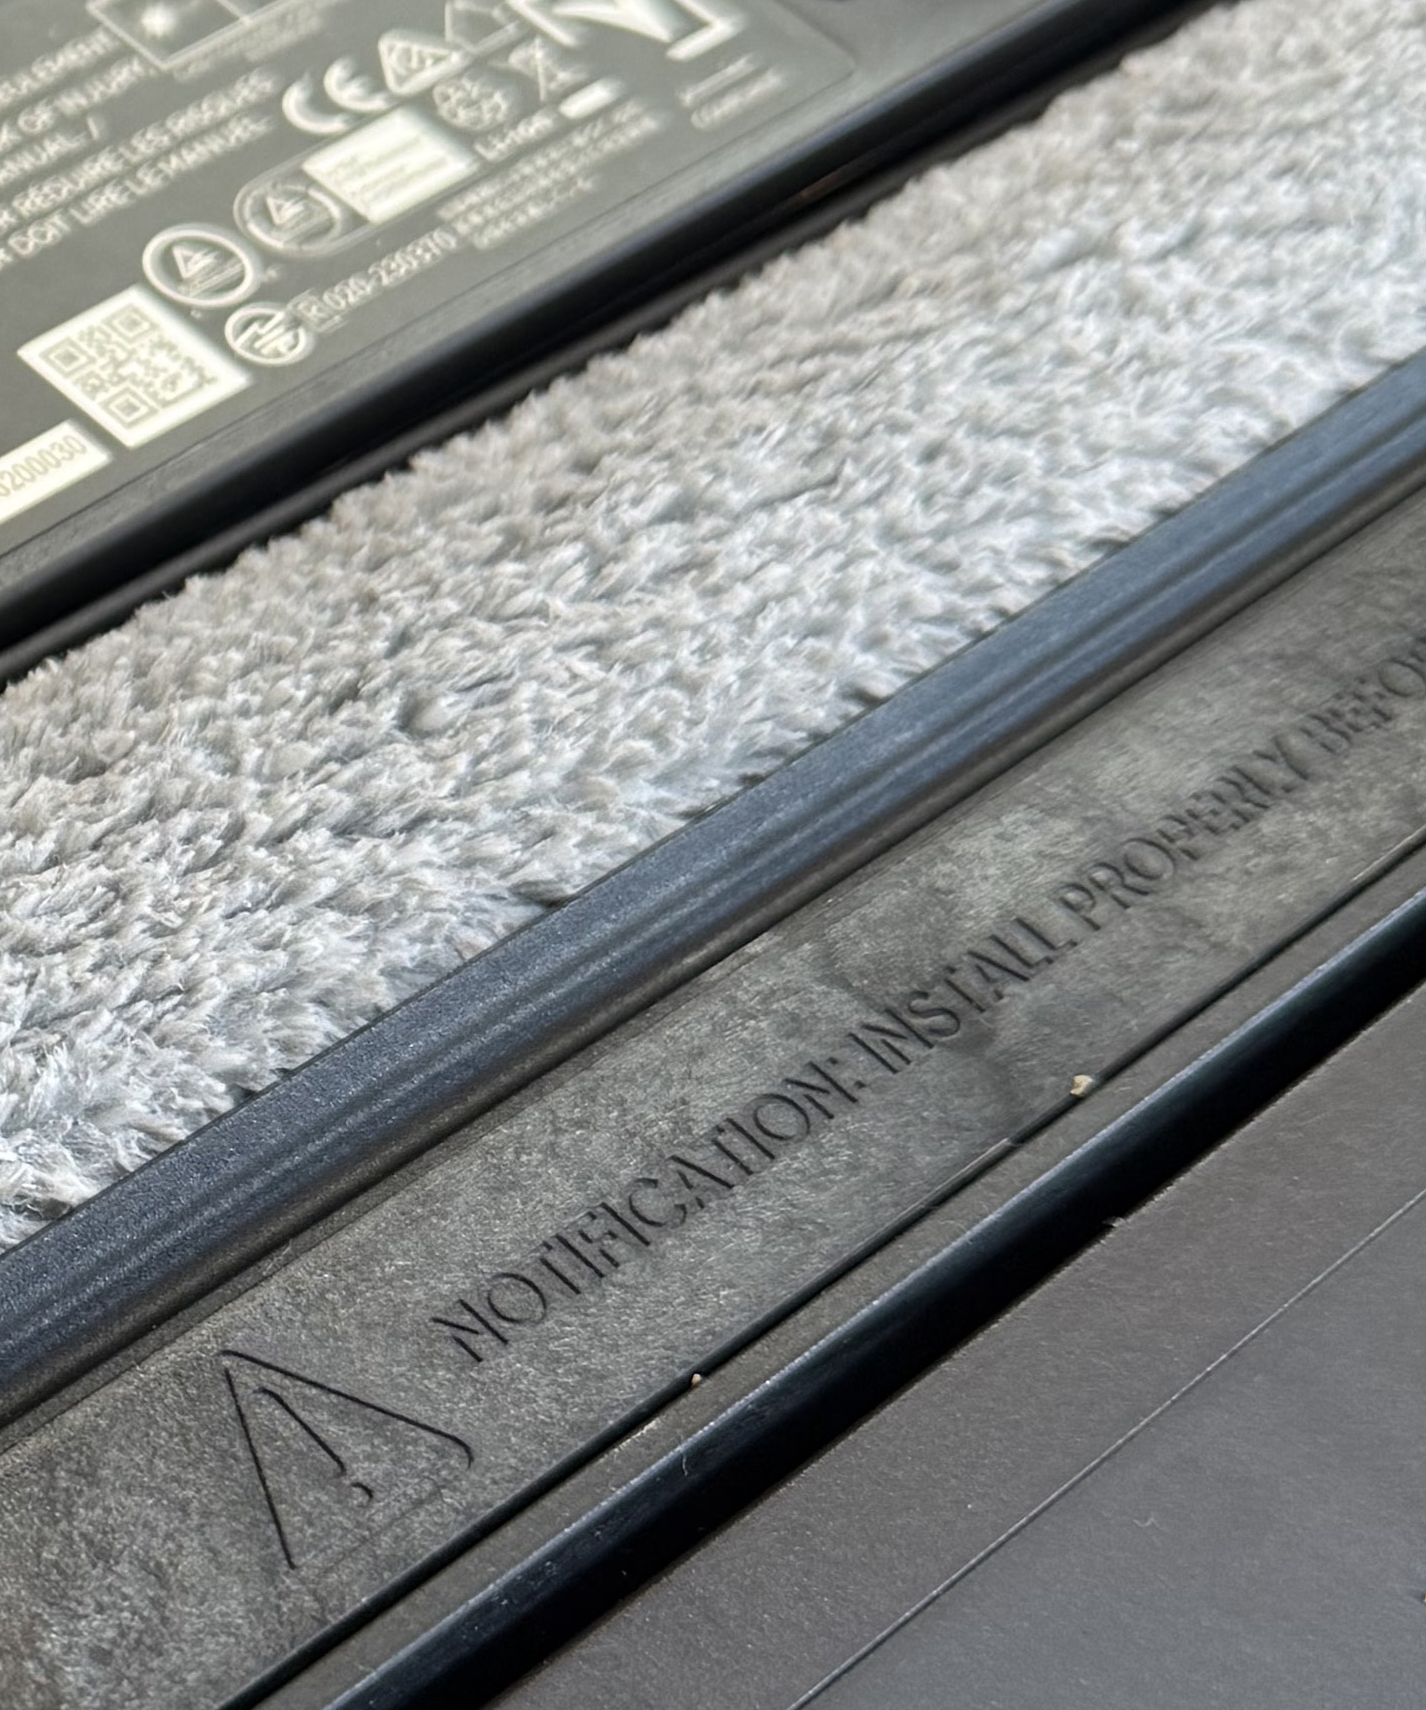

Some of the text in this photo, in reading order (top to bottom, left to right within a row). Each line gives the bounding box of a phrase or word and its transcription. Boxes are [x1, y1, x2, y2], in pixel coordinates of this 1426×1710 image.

[429, 1055, 866, 1364] NOTIFICATION:
[849, 917, 1078, 1075] INSTALL
[1057, 733, 1310, 932] PROPERLY
